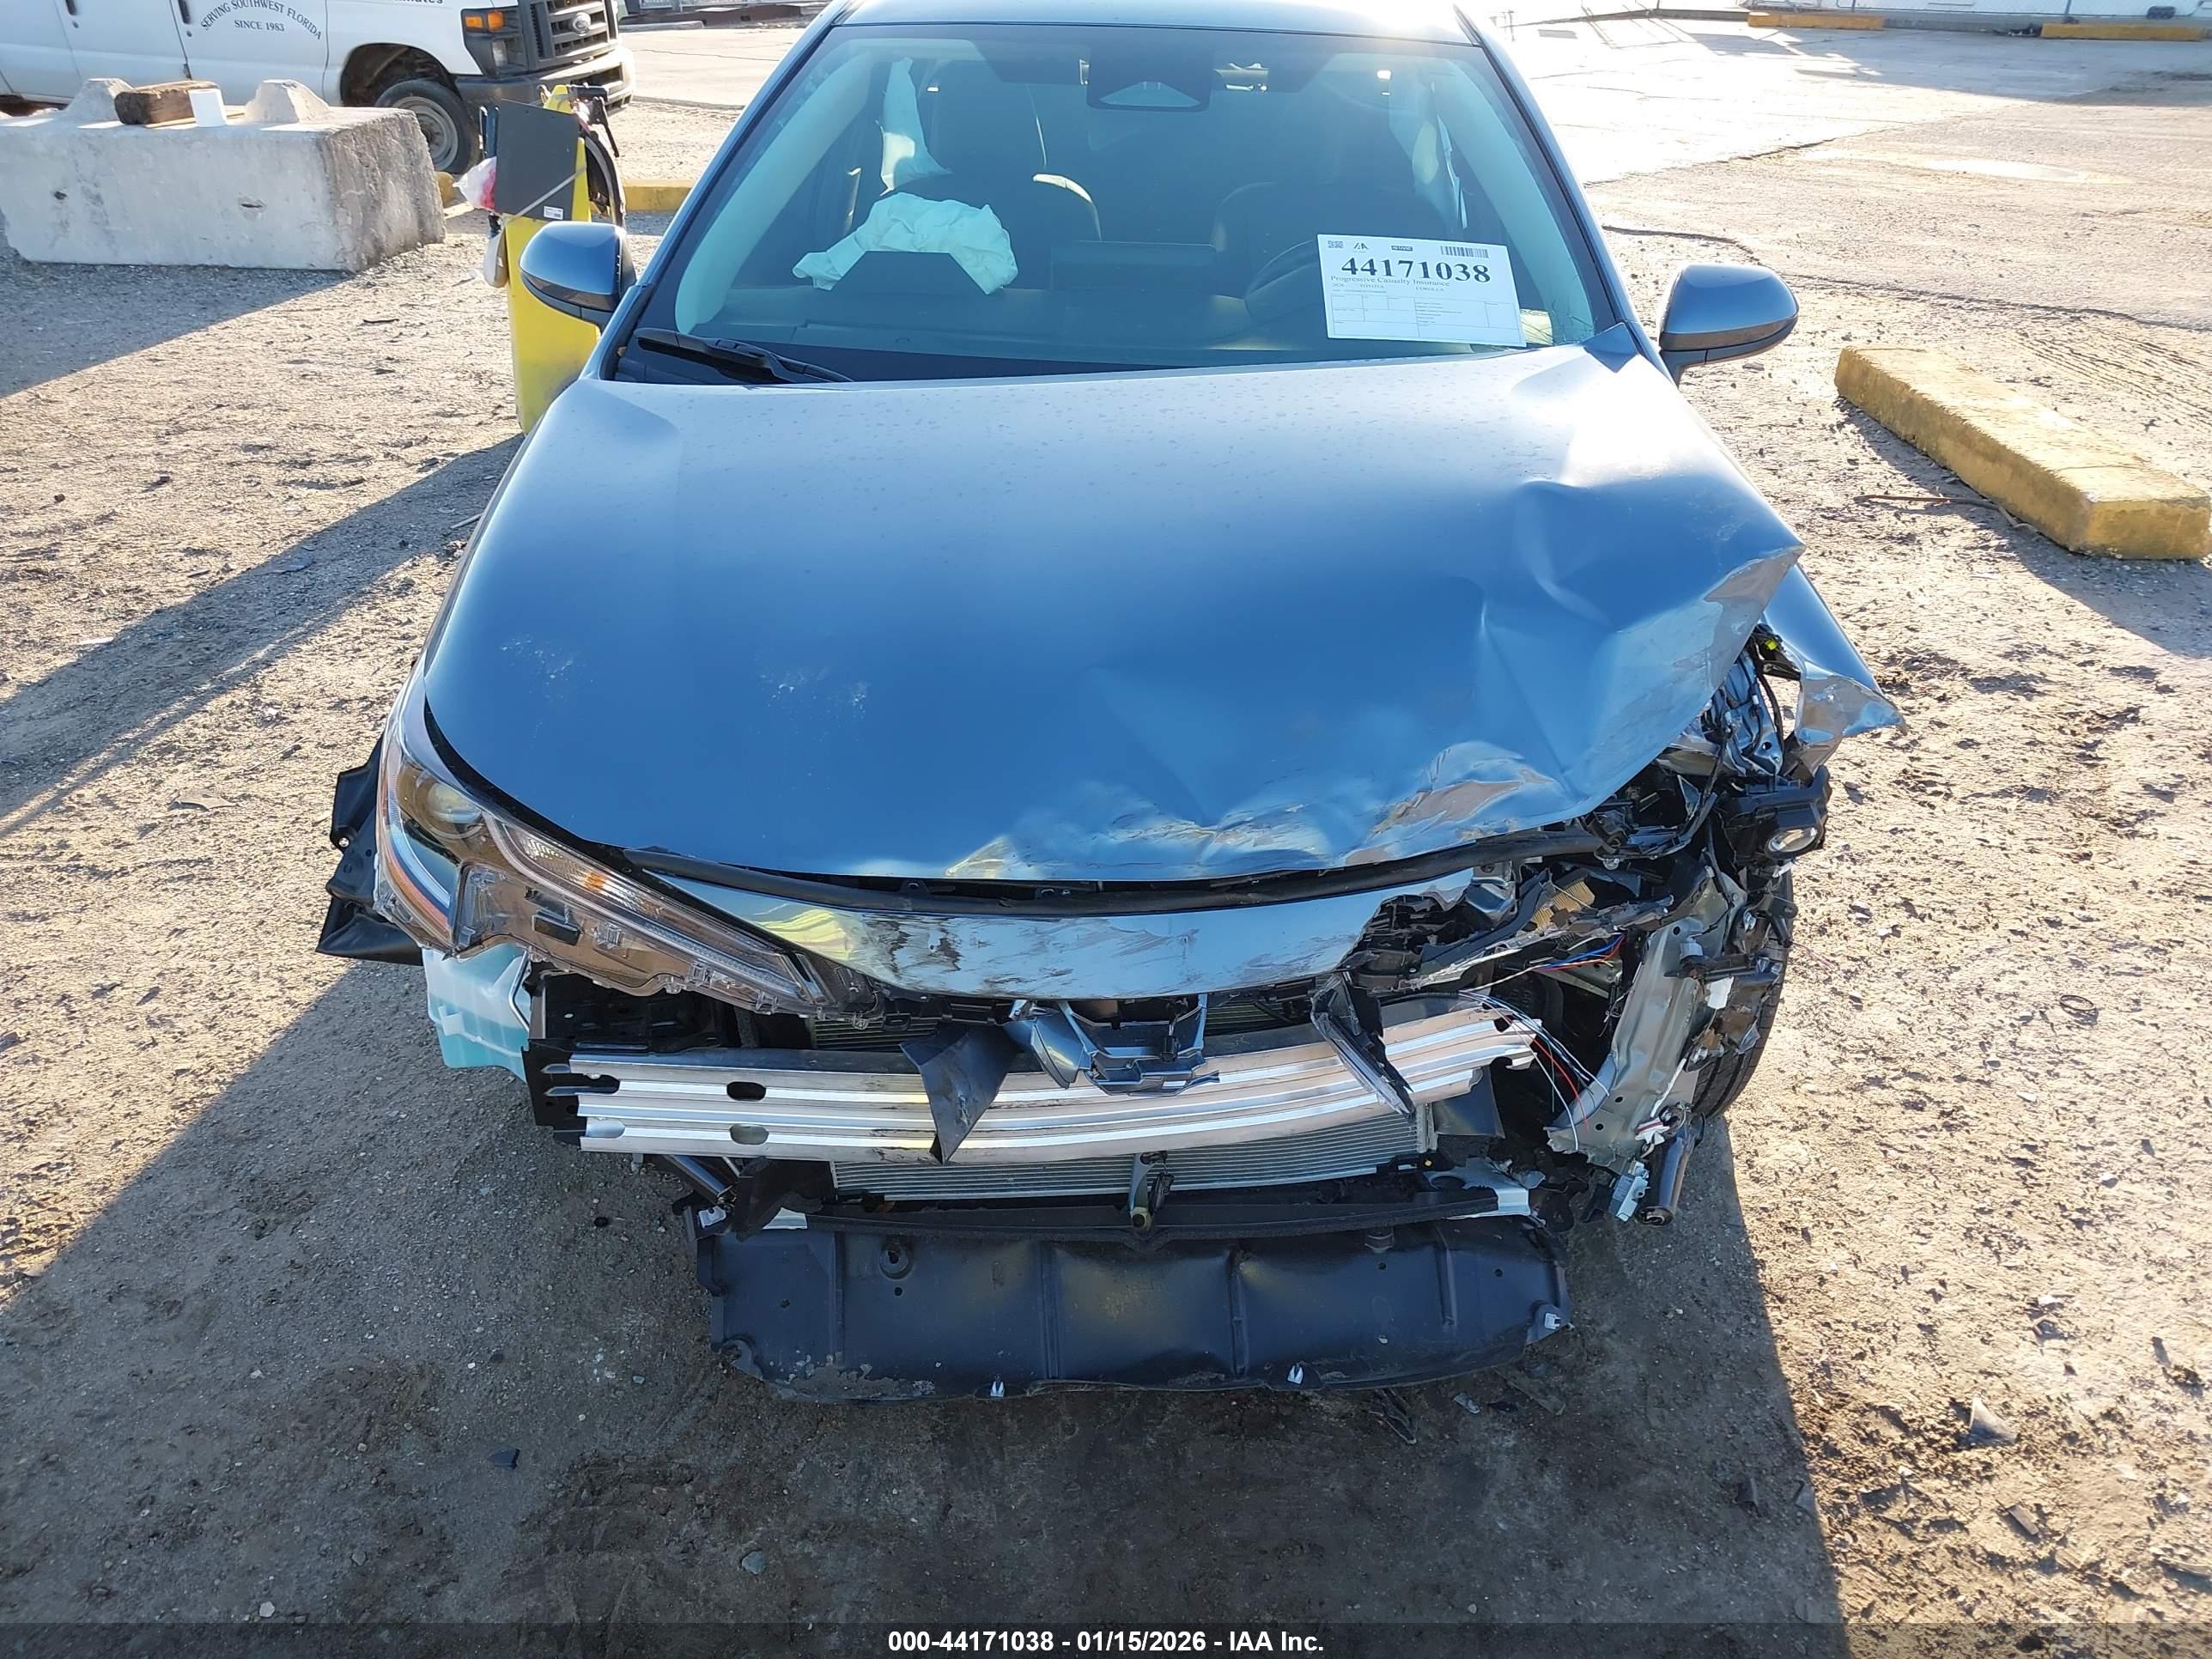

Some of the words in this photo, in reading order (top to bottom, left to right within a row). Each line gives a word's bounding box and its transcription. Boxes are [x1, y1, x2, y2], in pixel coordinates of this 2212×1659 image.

[201, 3, 231, 30] SERVING
[231, 0, 285, 13] SOUTHWEST
[287, 8, 322, 40] FLORIDA
[234, 20, 263, 29] SINCE
[265, 22, 284, 32] 1983
[1341, 258, 1491, 283] 44171038
[1331, 275, 1376, 283] Progressive
[1376, 276, 1409, 285] Casualty
[1413, 278, 1450, 287] Insurance
